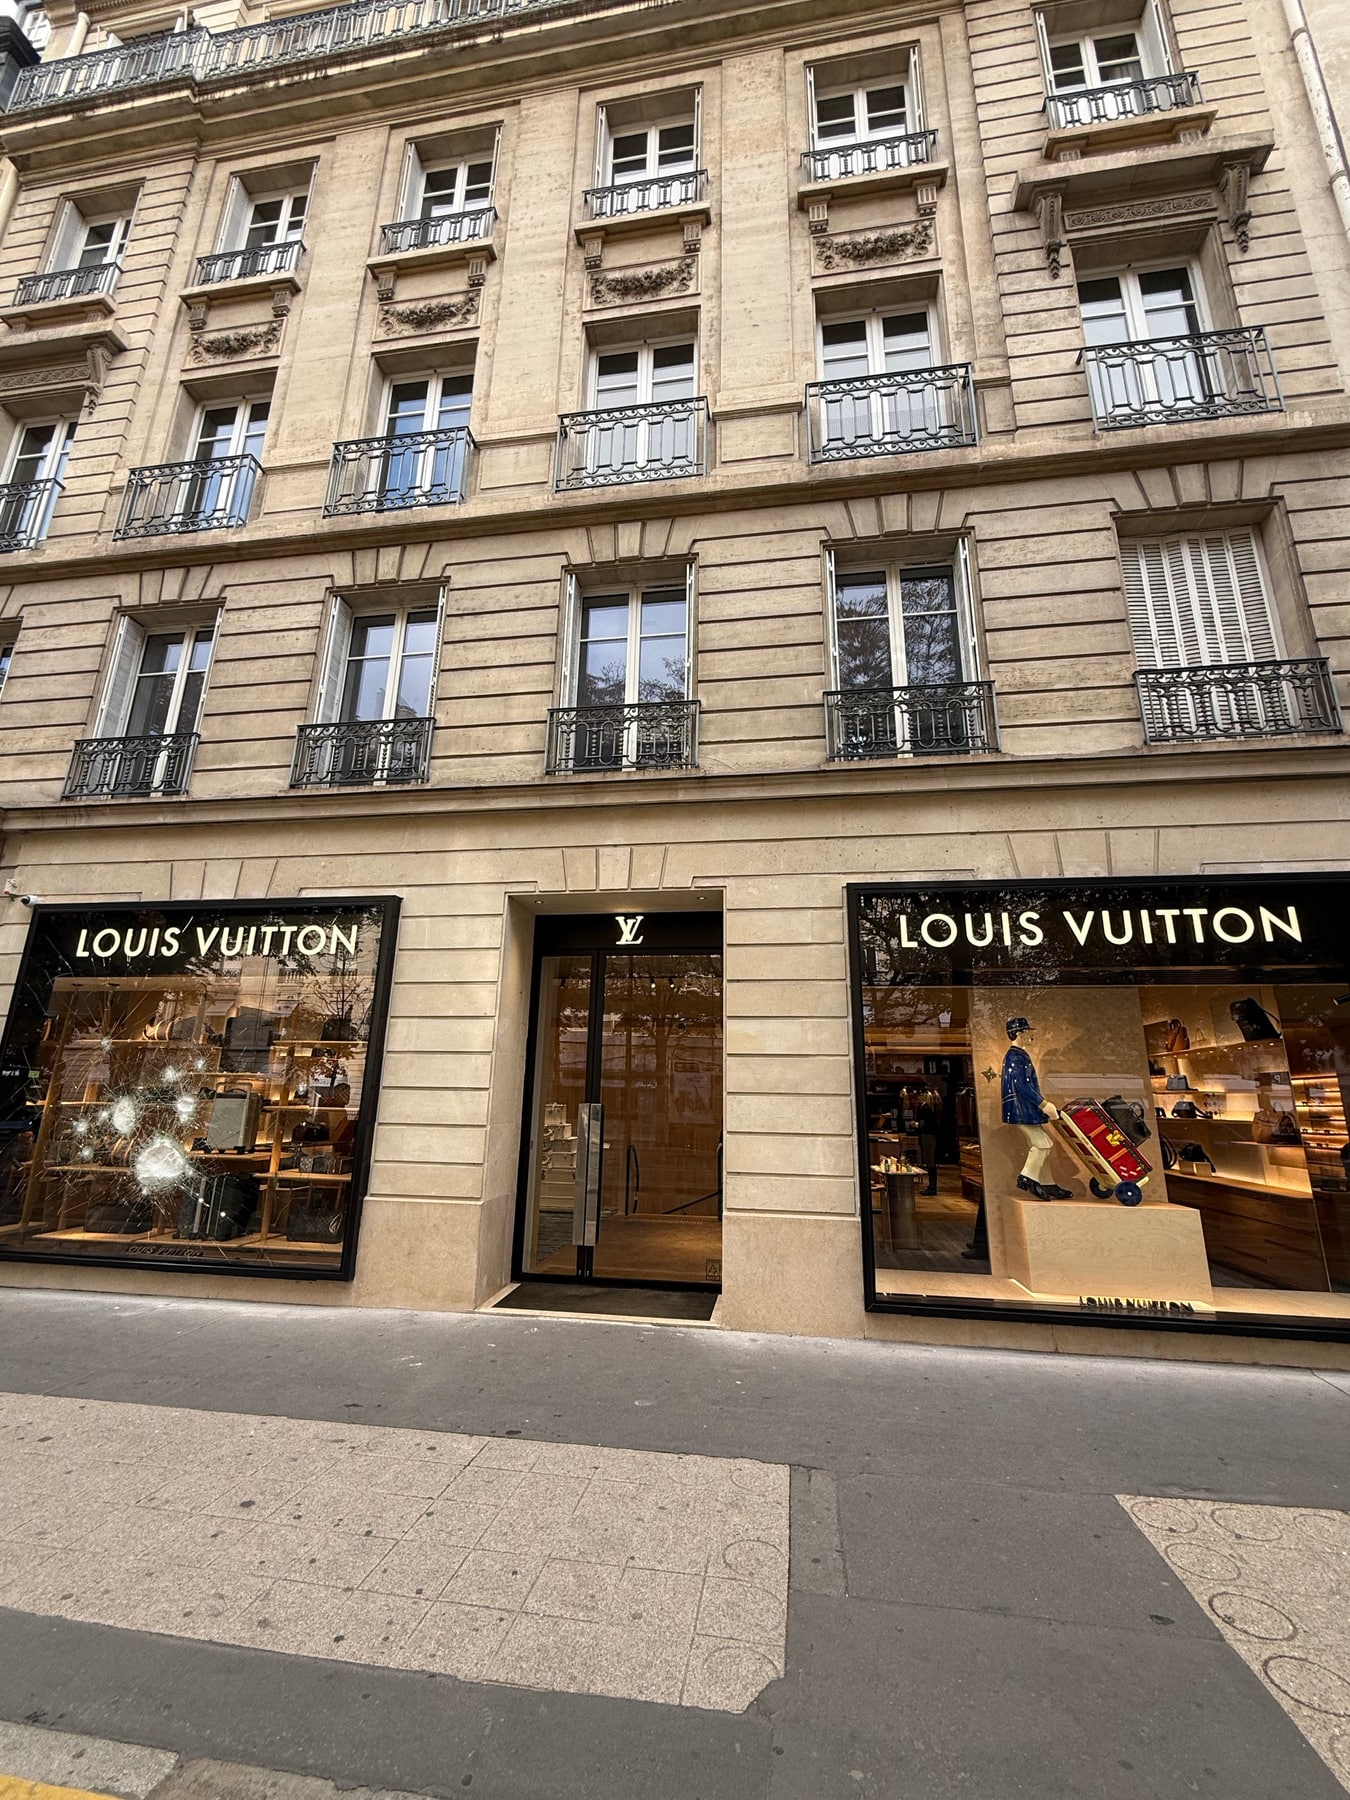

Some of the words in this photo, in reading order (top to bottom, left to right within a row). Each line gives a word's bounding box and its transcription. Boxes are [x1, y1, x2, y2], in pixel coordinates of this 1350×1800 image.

[75, 927, 181, 958] LOUIS
[196, 924, 358, 957] VUITTON
[899, 911, 1044, 949] LOUIS
[1062, 906, 1302, 946] VUITTON
